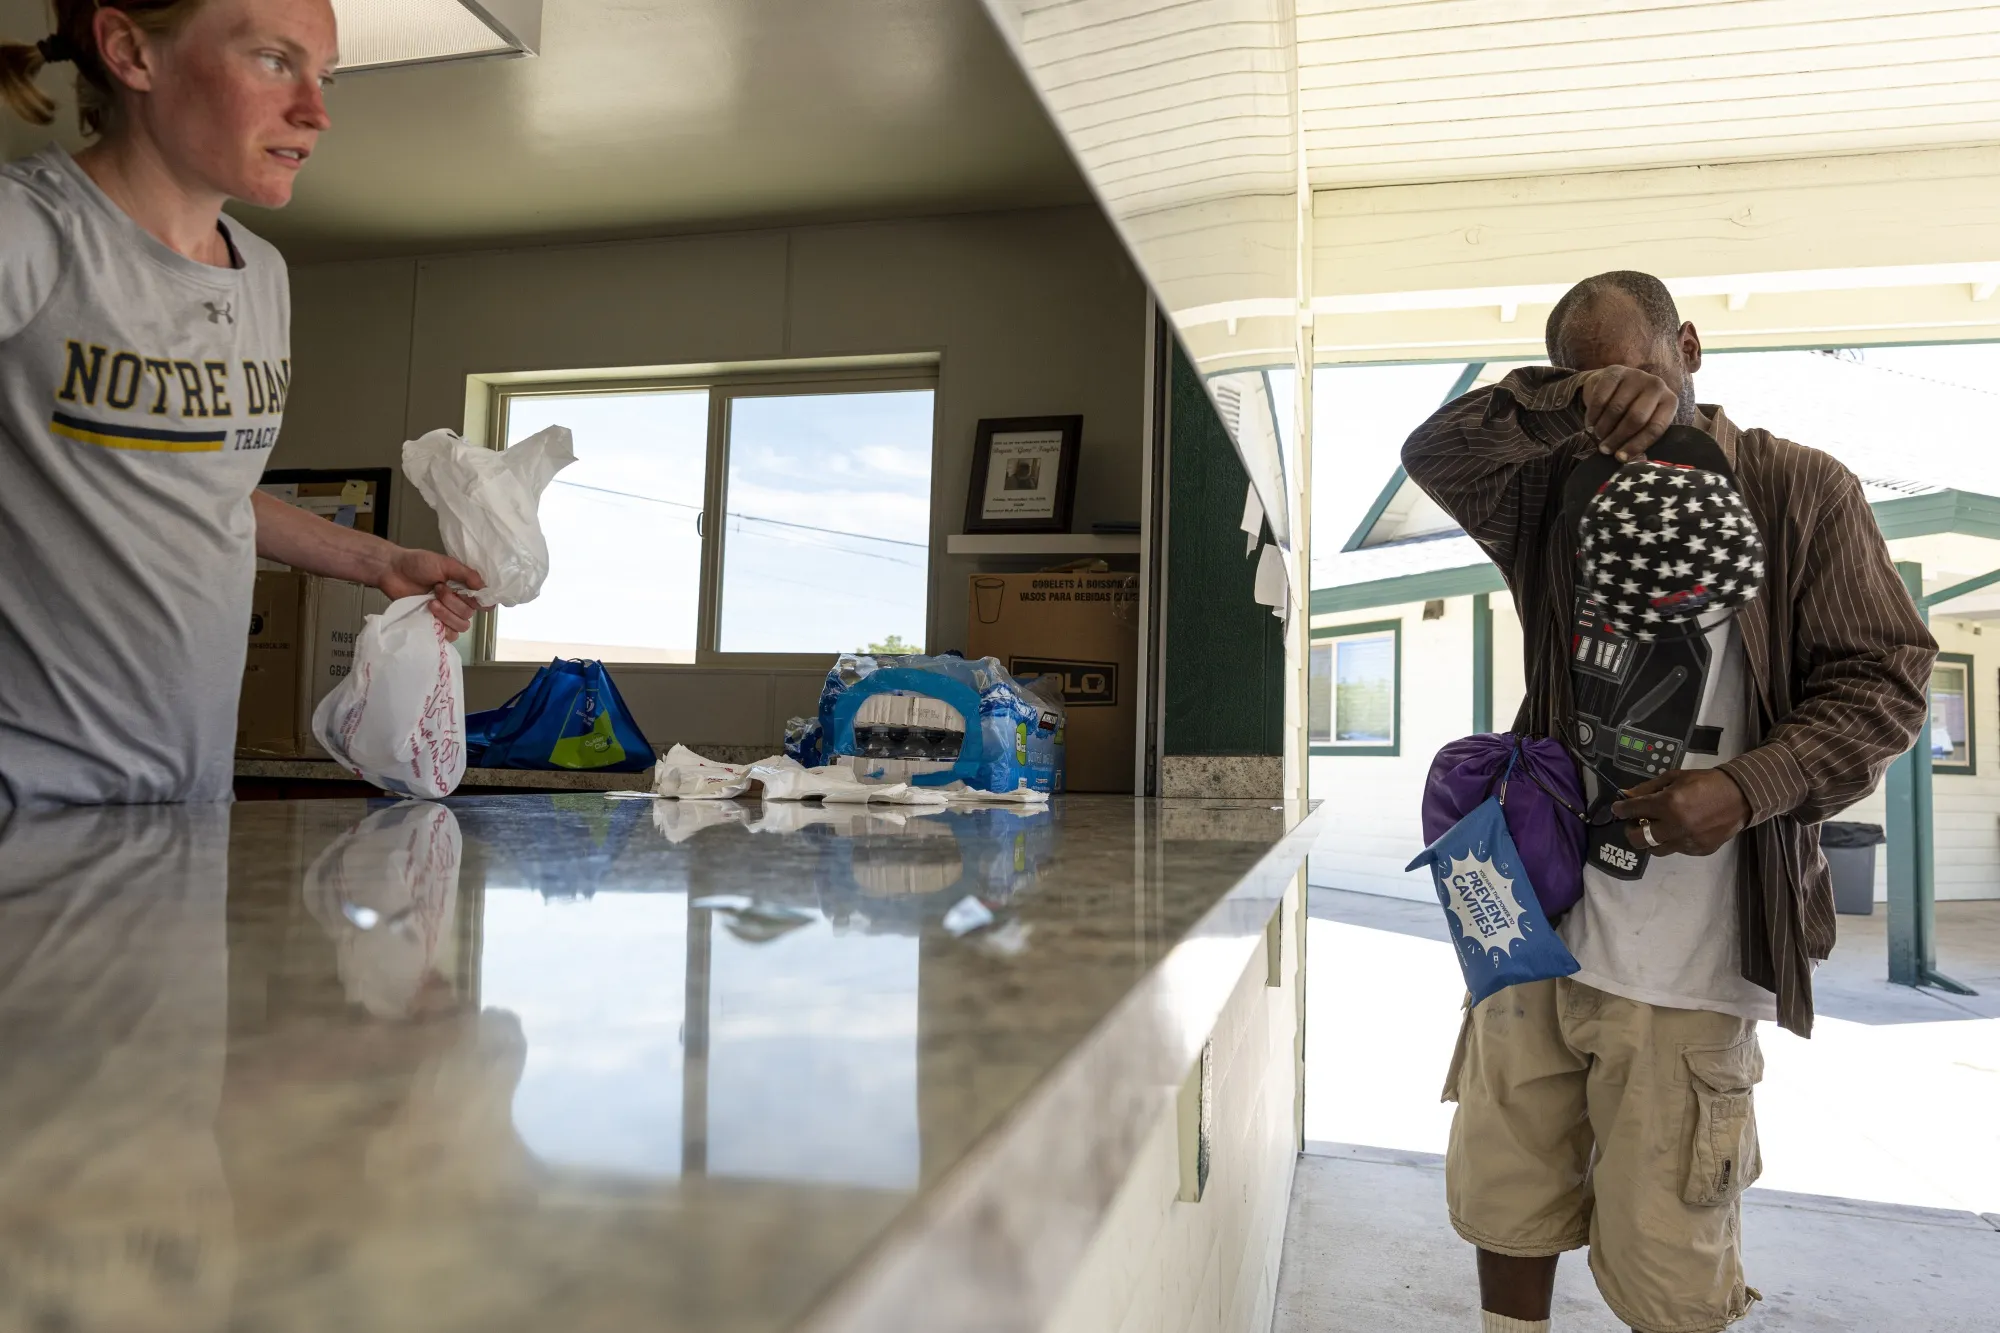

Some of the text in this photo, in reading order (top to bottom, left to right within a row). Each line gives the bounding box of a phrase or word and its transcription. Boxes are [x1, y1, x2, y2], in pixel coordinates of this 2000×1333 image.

[58, 340, 232, 417] NOTRE
[1032, 579, 1075, 589] GOBELETS
[1020, 592, 1046, 602] VASOS
[1049, 592, 1071, 602] PARA
[1075, 592, 1111, 602] BEBIDAS
[331, 630, 353, 643] KN95
[1600, 843, 1638, 862] STAR
[1600, 850, 1638, 870] WARS
[1452, 874, 1497, 939] CAVITIES!
[1465, 871, 1510, 930] PREVENT
[1478, 869, 1515, 926] YOU HAVE THE POWER TO
